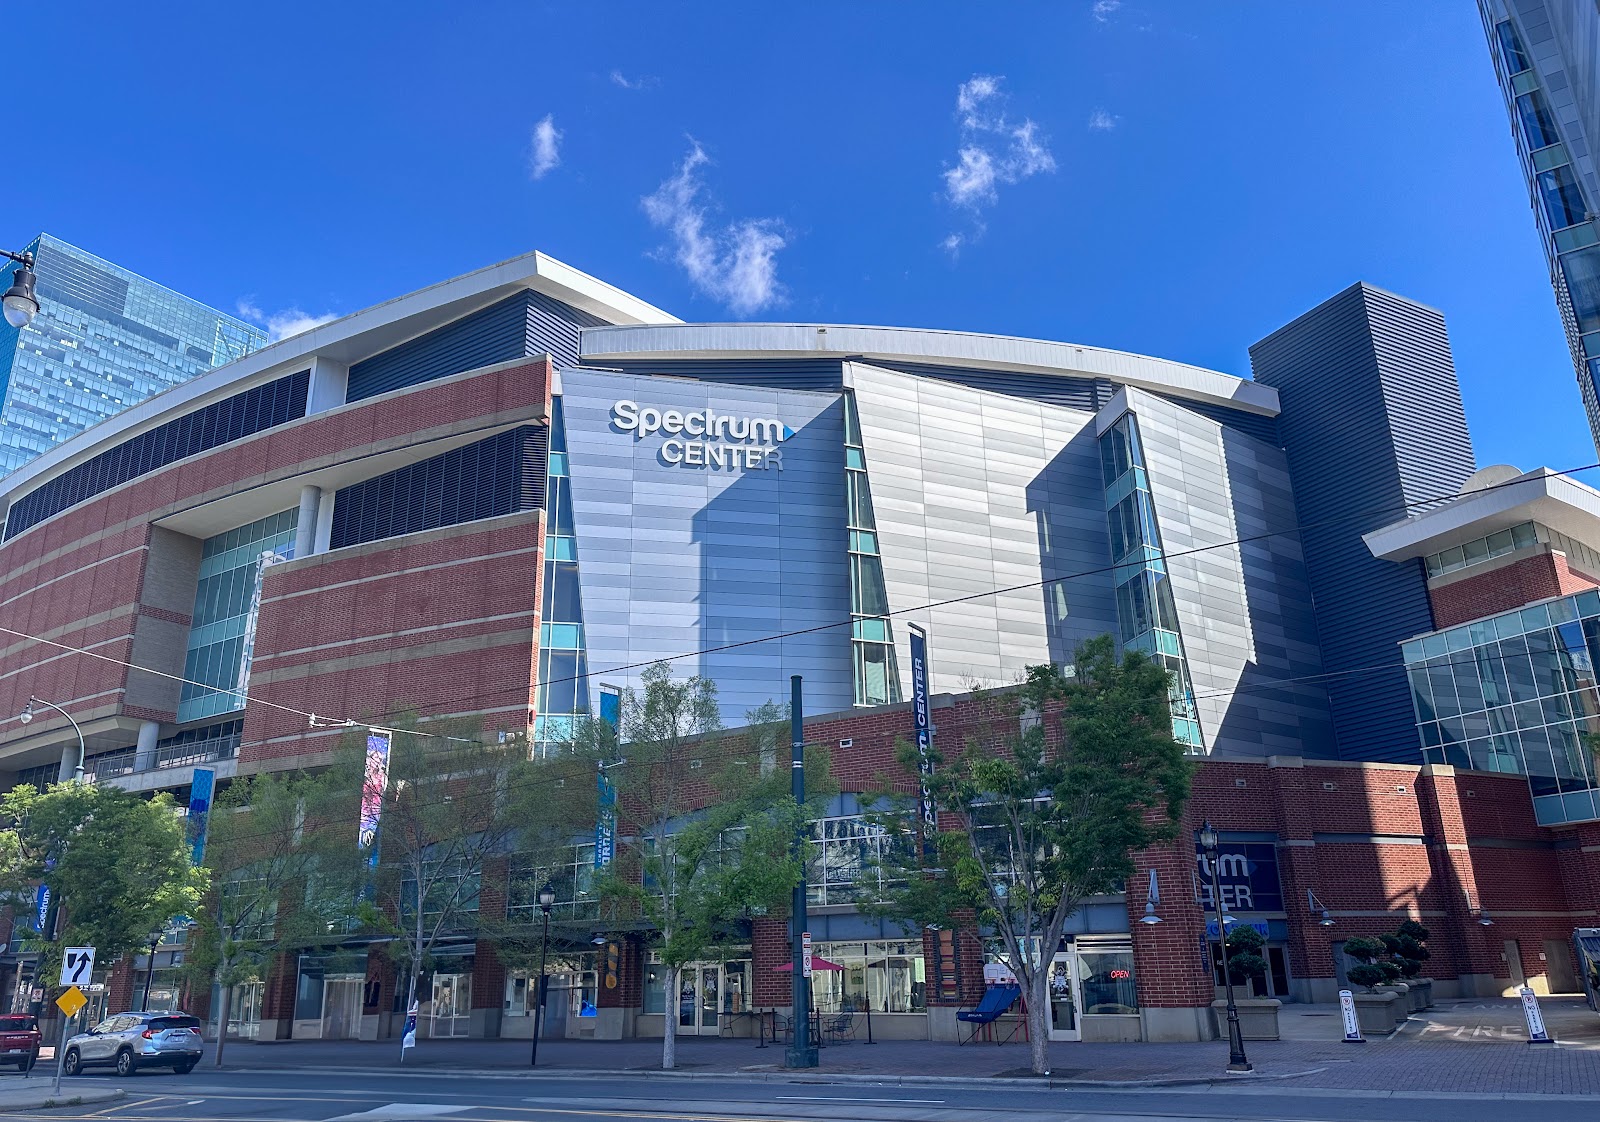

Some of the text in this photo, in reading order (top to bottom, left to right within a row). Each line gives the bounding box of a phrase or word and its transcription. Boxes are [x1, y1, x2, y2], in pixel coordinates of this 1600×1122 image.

[613, 400, 784, 442] Spectrum
[661, 439, 784, 471] CENTER
[914, 657, 934, 840] Specum CENTER
[37, 892, 50, 930] Spectrum
[1110, 970, 1130, 979] OPEN
